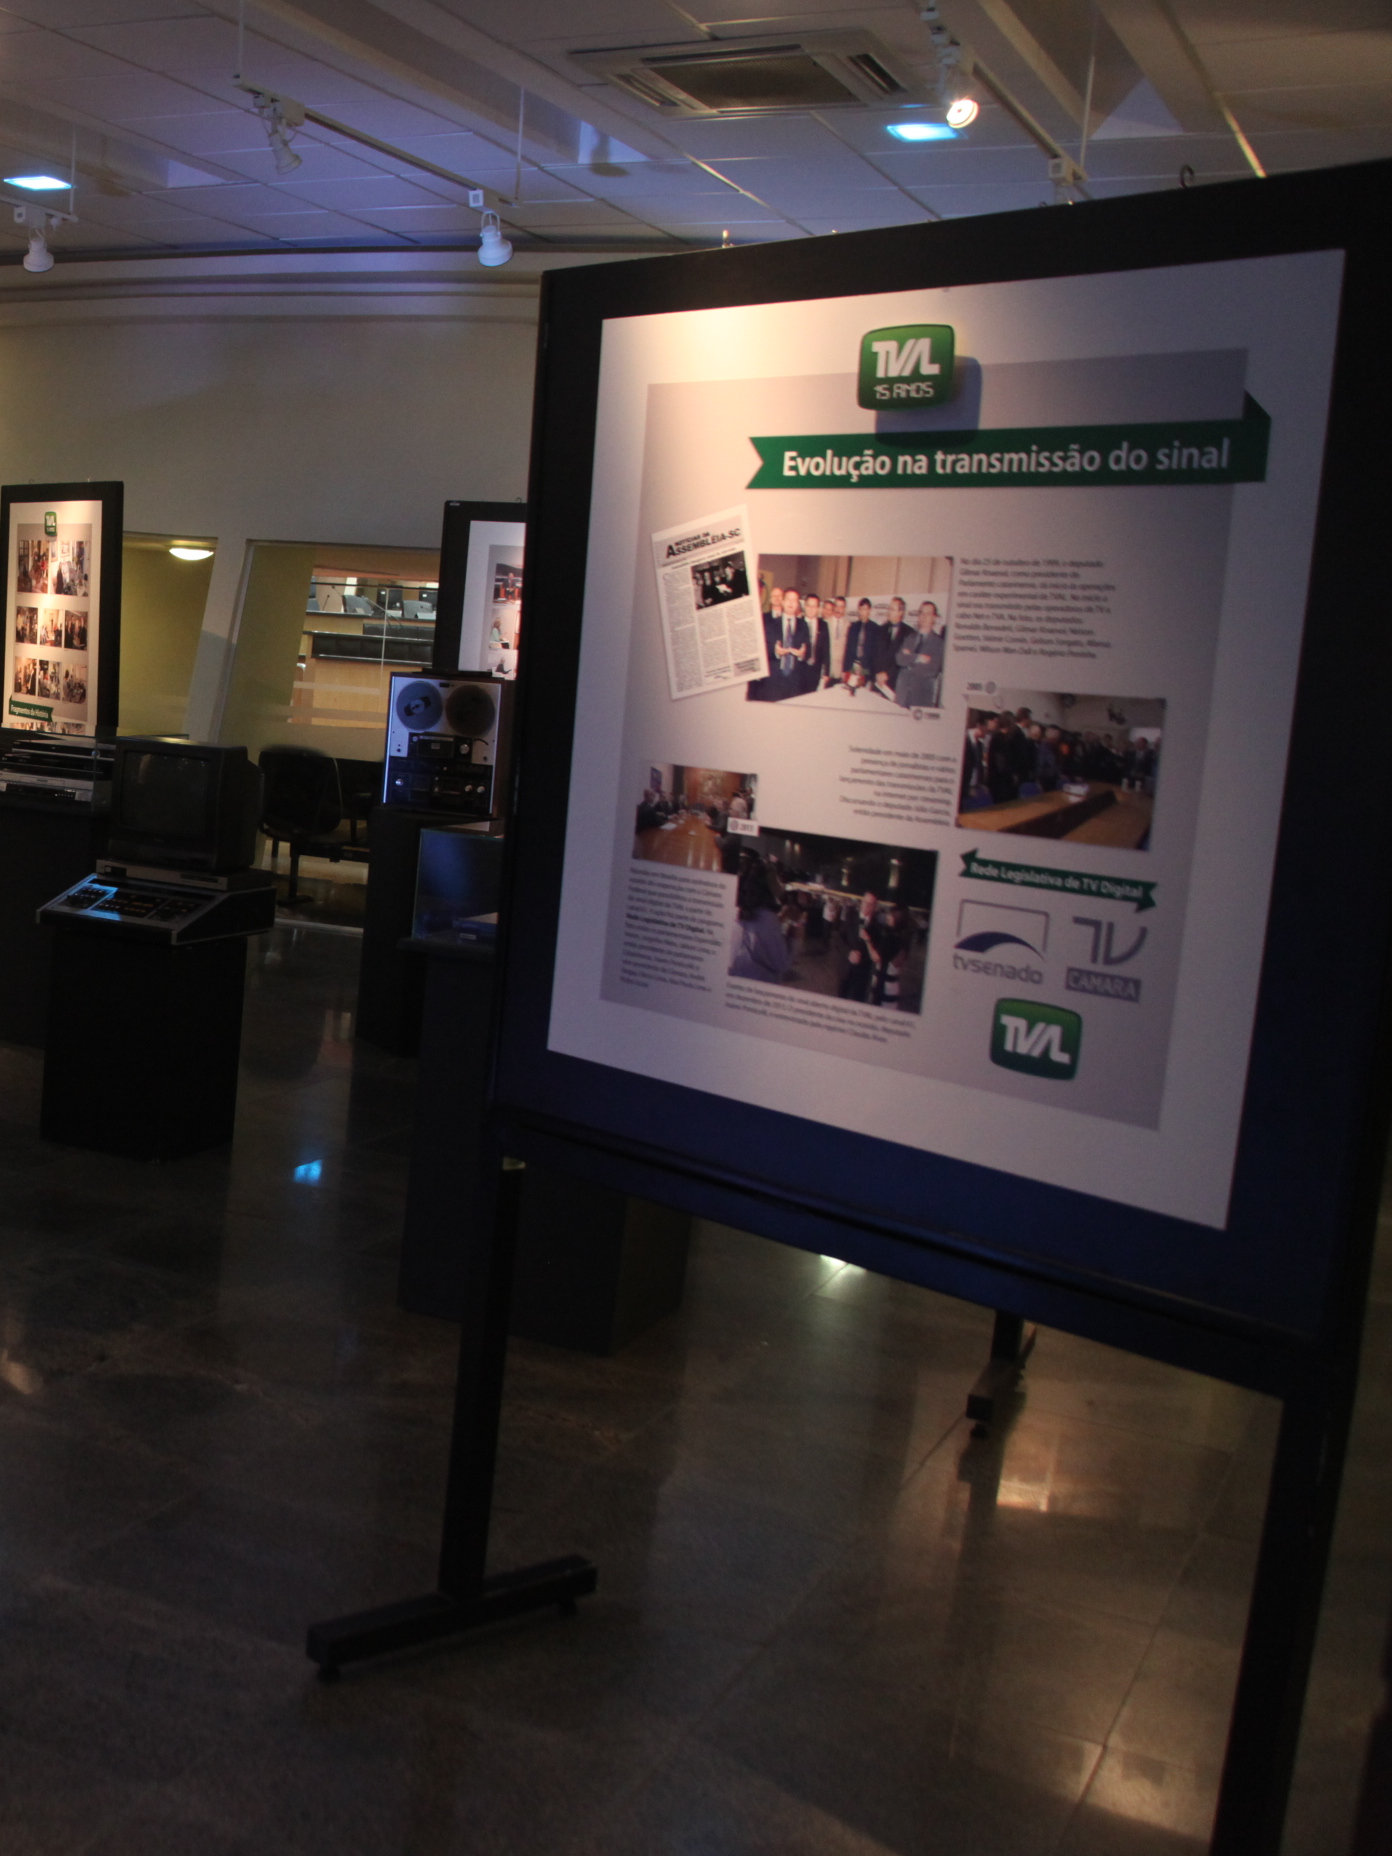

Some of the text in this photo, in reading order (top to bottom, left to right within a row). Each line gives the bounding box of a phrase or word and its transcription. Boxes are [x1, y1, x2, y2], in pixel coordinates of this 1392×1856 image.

[874, 382, 934, 399] 15 ANOS
[782, 437, 1230, 482] Evolução na transmissão do sinal
[970, 862, 1143, 898] Rede Legislativa de TV Digital
